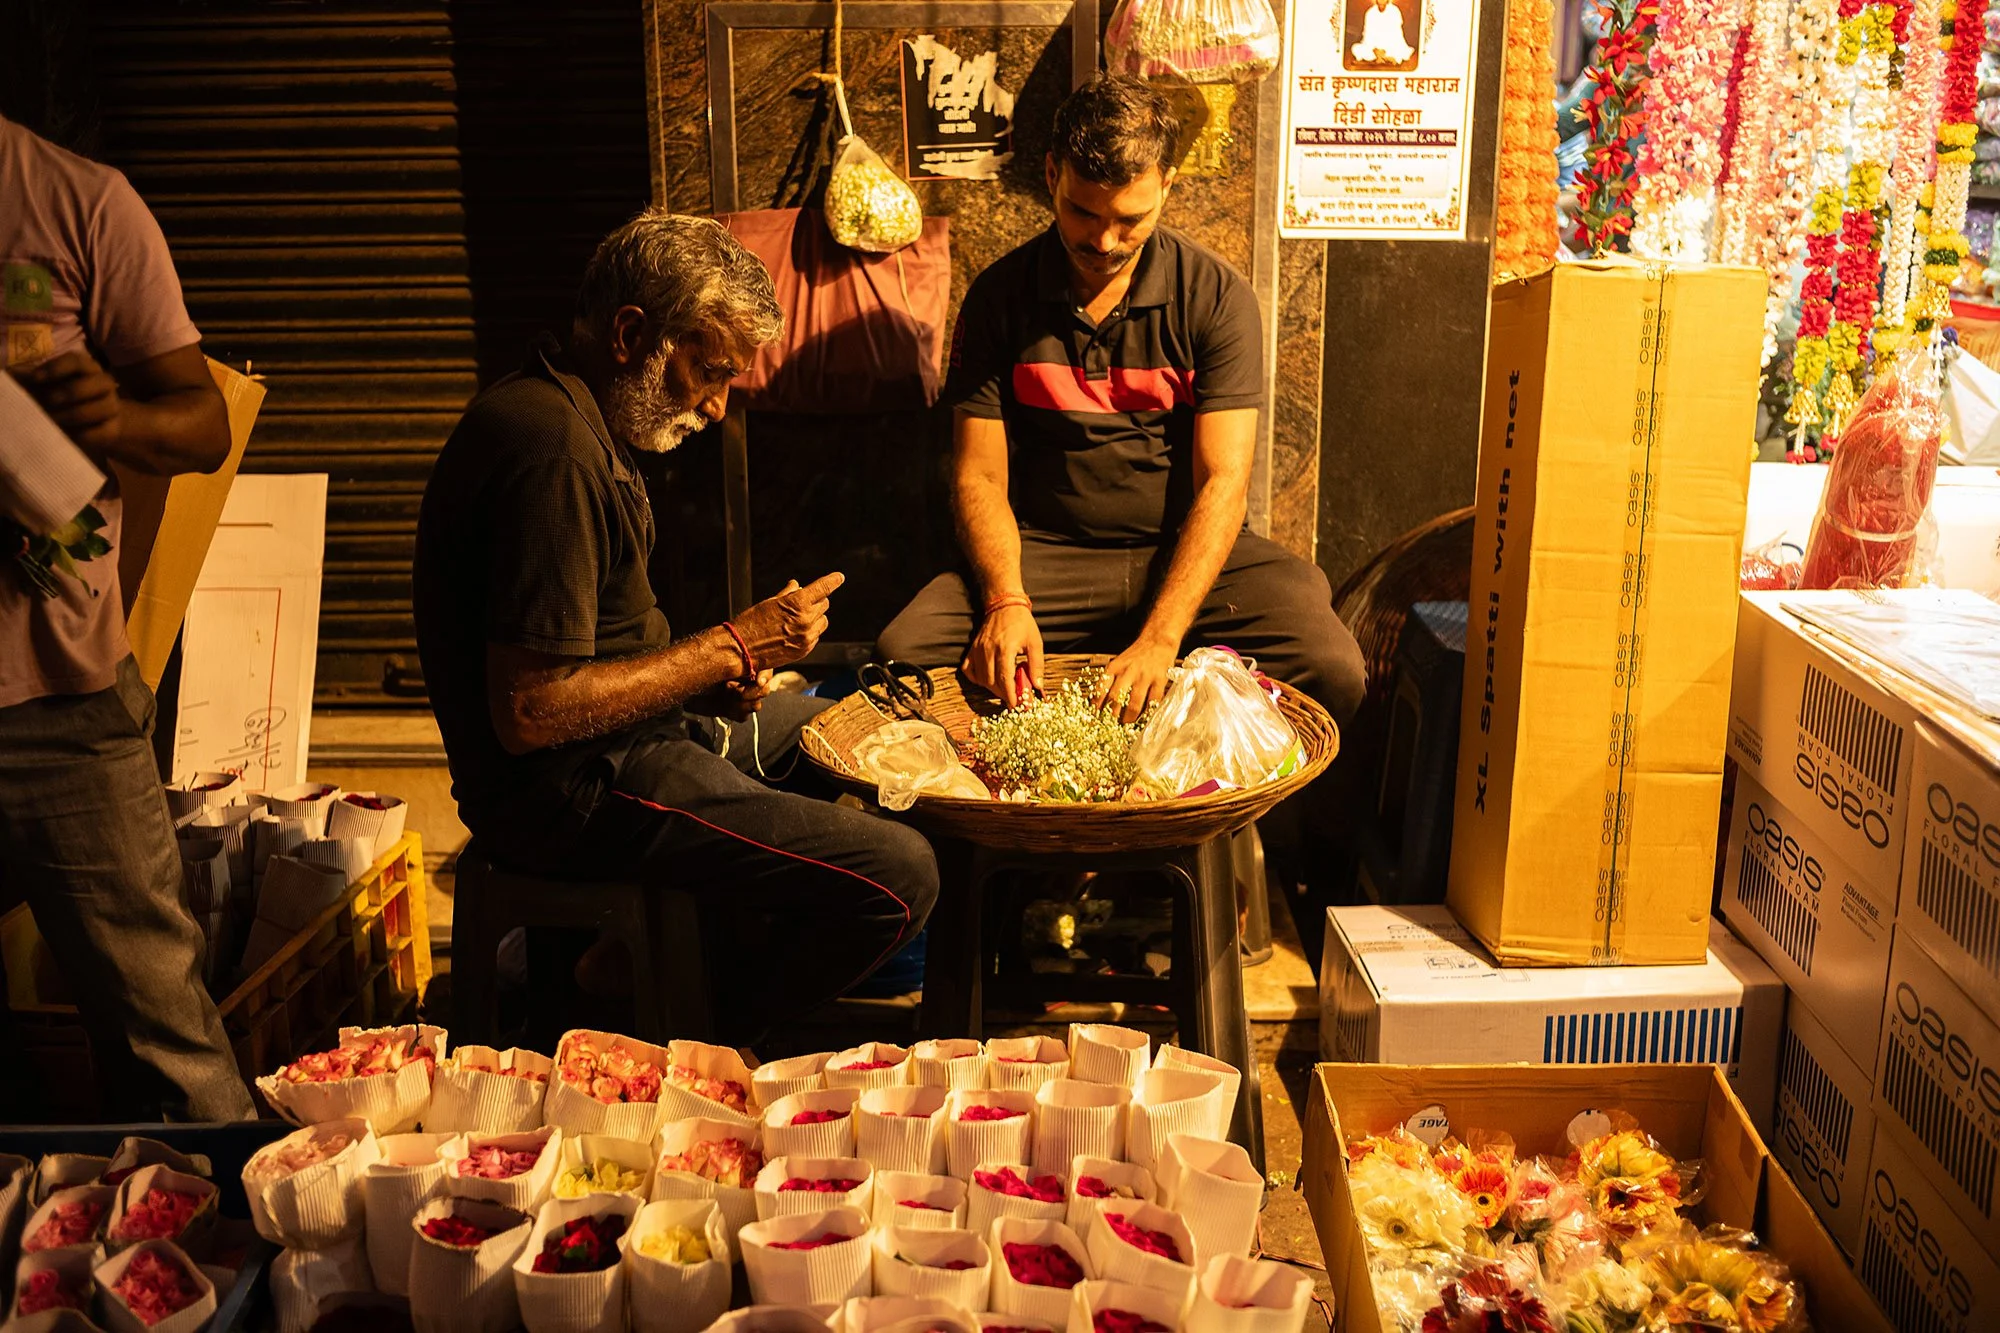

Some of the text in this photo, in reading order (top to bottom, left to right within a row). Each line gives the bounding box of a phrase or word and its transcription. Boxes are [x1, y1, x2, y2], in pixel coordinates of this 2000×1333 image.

[1331, 77, 1398, 98] कृष्णदास
[1404, 78, 1460, 95] महाराज
[1333, 102, 1422, 126] दिंडी सोहळा
[1475, 370, 1520, 815] XL Spatti with net
[1797, 731, 1831, 767] FOAM
[1839, 764, 1893, 816] FLORAL
[1744, 830, 1819, 914] FLORAL FOAM
[1923, 818, 1981, 877] FLORAL
[1844, 882, 1880, 920] ADVANTAGE
[1891, 1013, 1945, 1084] FLORAL
[1801, 1117, 1845, 1183] FLORAL
[1870, 1199, 1917, 1275] FLORAL
